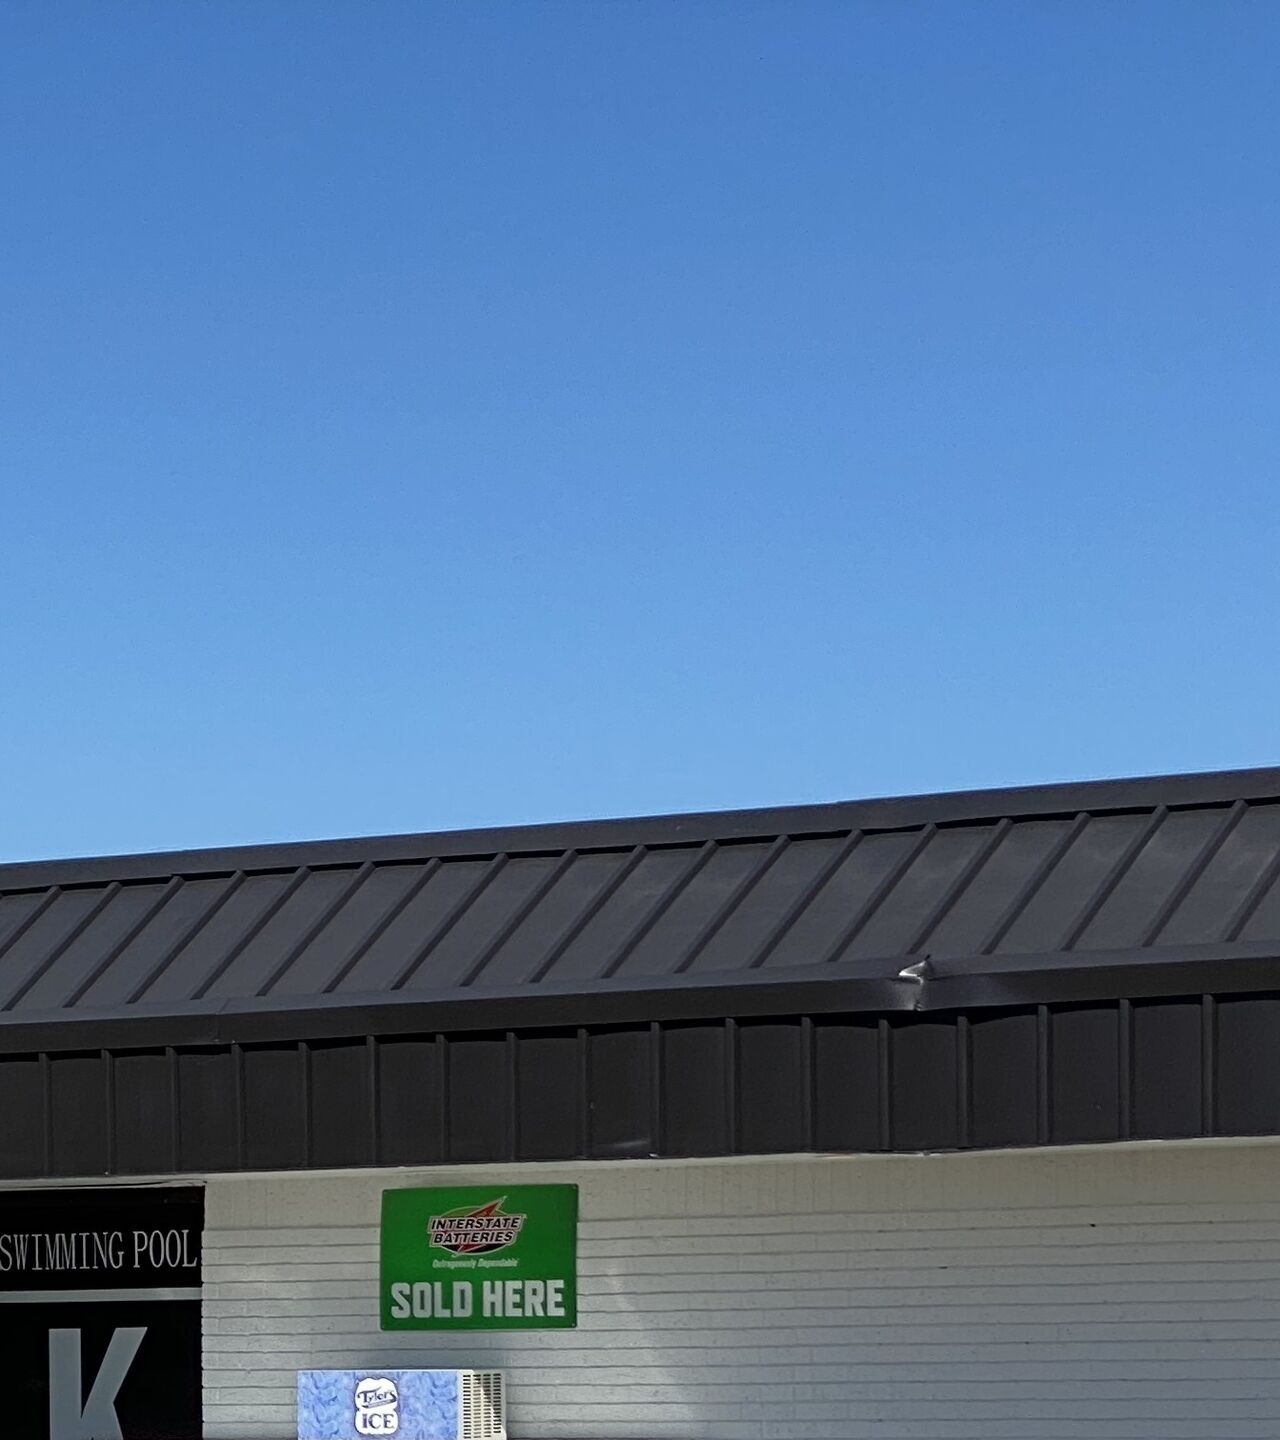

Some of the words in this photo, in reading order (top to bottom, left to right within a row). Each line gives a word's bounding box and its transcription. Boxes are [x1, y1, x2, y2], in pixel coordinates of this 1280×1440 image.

[430, 1217, 520, 1230] INTERSTATE
[433, 1231, 514, 1243] BATTERIES
[133, 1229, 198, 1268] POOL
[391, 1281, 473, 1319] SOLD
[482, 1279, 565, 1317] HERE
[362, 1413, 394, 1429] ICE
